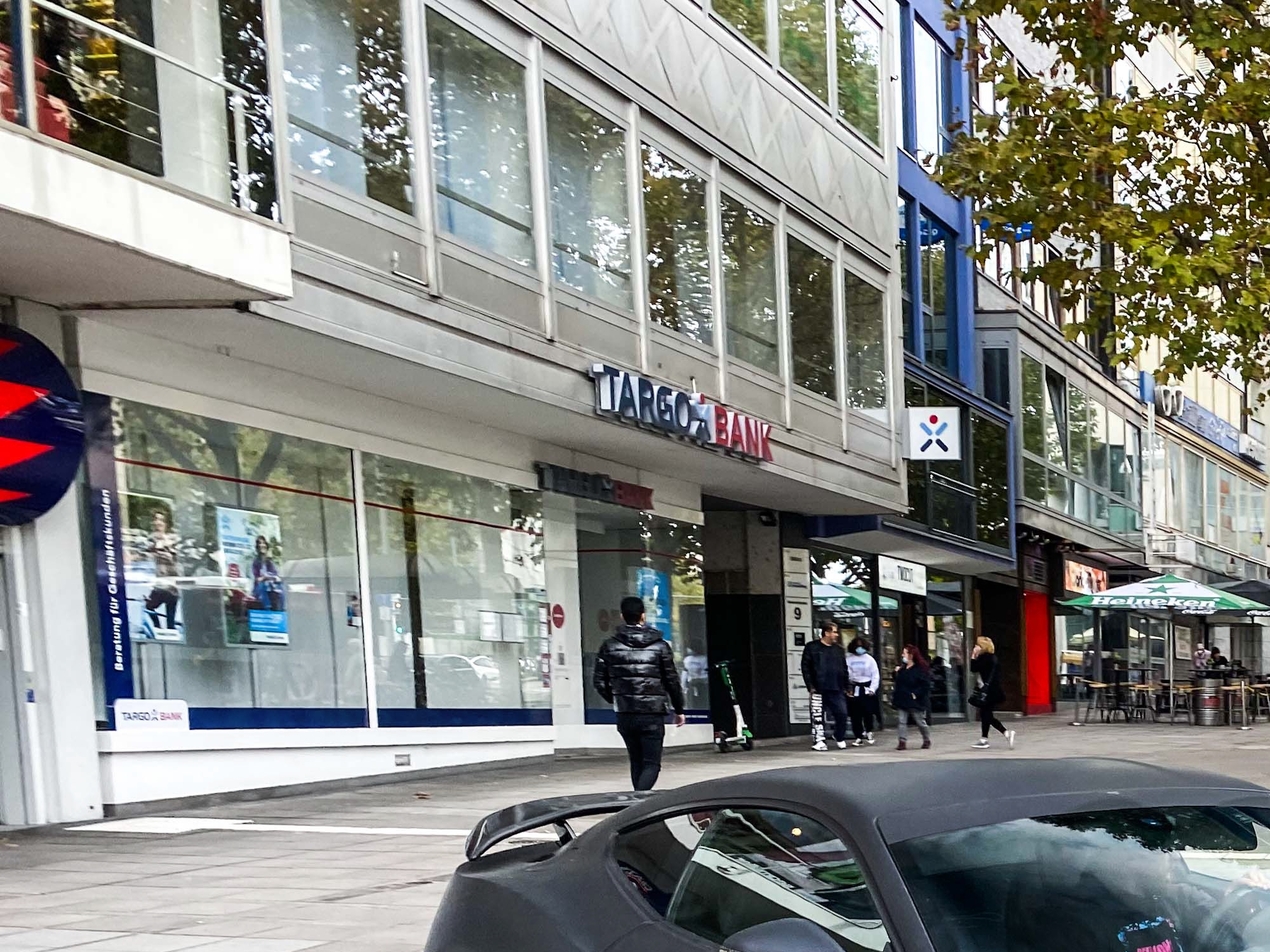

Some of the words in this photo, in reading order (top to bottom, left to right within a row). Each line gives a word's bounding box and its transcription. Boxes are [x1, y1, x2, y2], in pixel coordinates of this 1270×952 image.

[593, 363, 692, 433] TARGO
[713, 404, 774, 462] BANK
[109, 596, 120, 615] für
[1091, 596, 1217, 608] Heineken
[794, 607, 802, 620] 9
[112, 618, 124, 671] Beratung
[121, 711, 150, 721] TARGO
[160, 711, 183, 721] BANK
